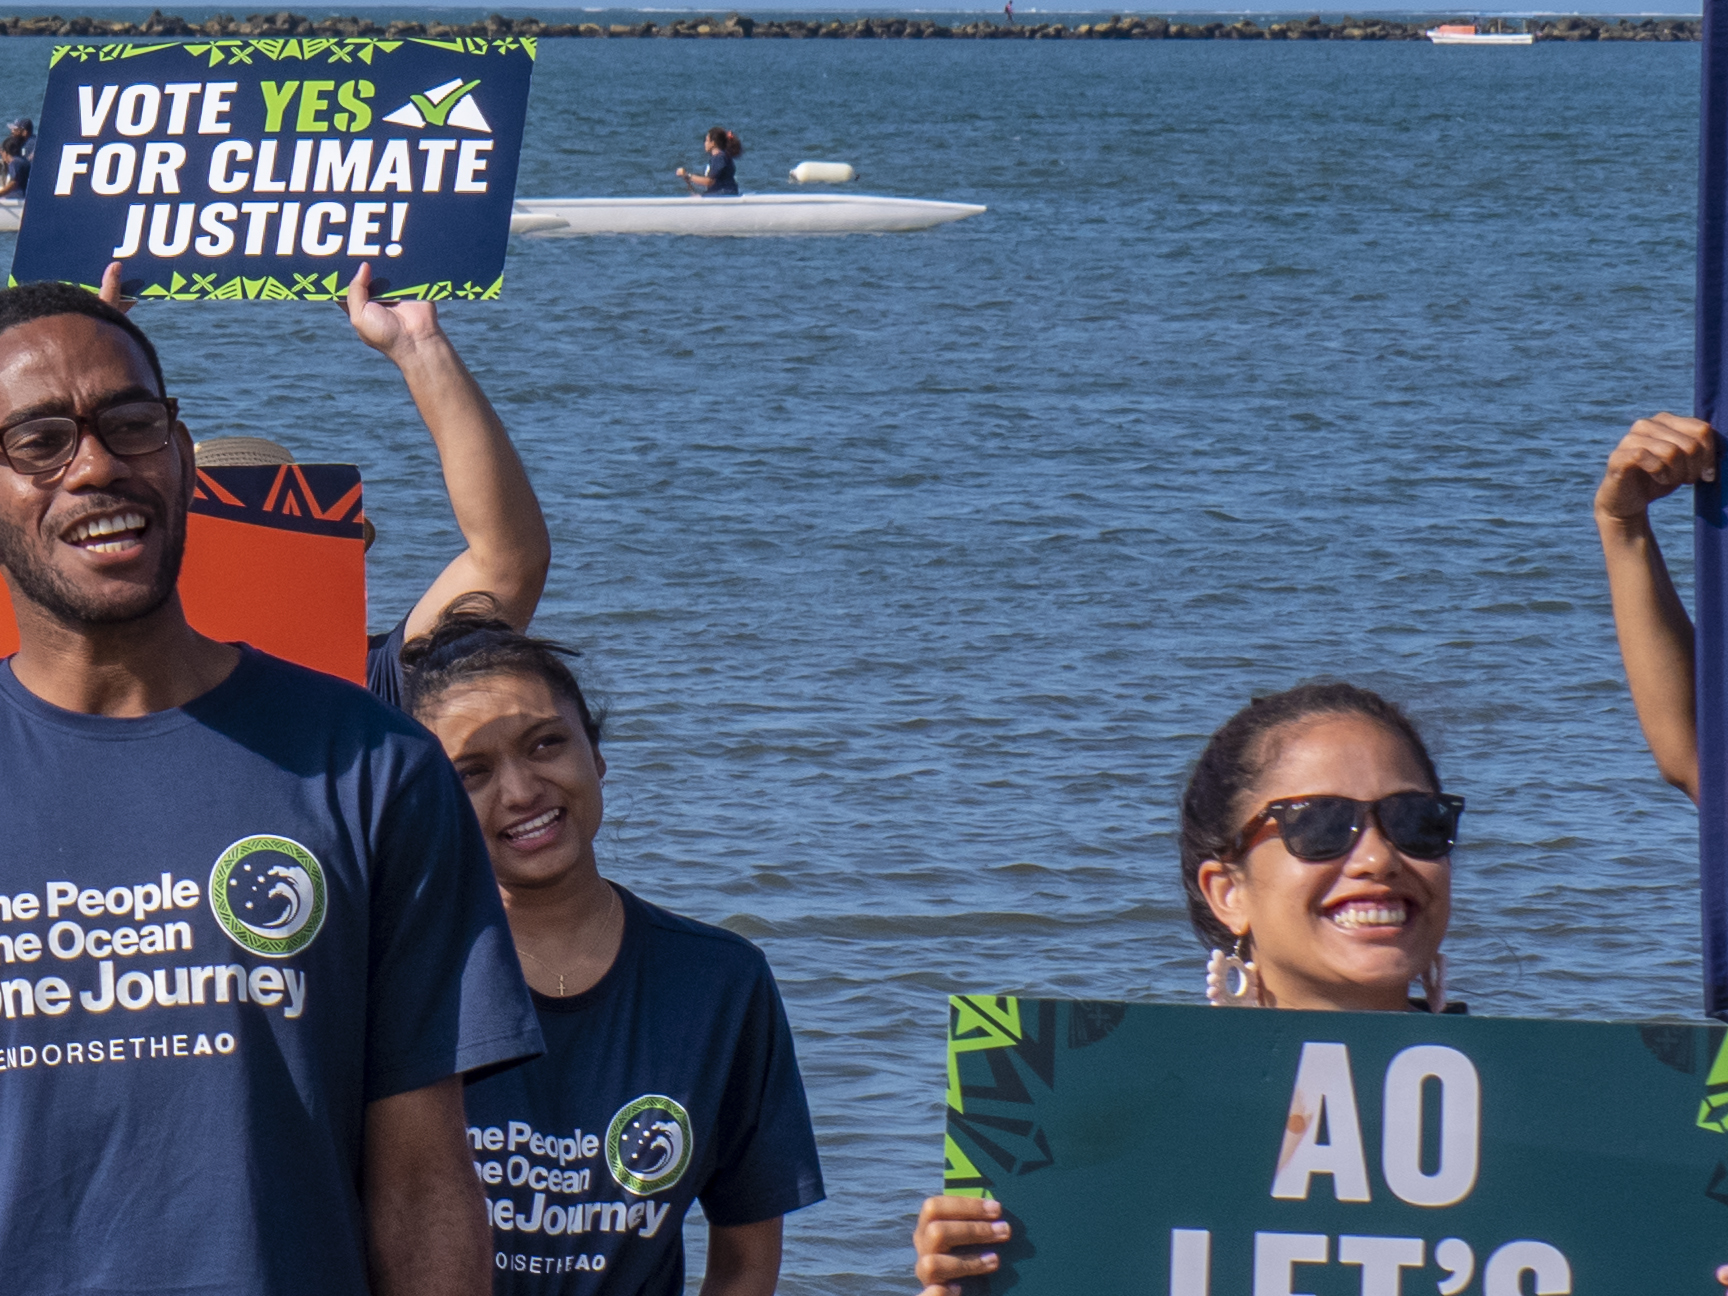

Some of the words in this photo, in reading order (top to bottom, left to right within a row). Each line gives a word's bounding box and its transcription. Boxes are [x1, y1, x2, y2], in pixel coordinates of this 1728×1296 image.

[78, 82, 238, 137] VOTE
[259, 79, 376, 133] YES
[54, 141, 186, 195] FOR
[207, 138, 494, 195] CLIMATE
[112, 201, 409, 258] JUSTICE!
[46, 872, 201, 921] People
[47, 919, 193, 960] Ocean
[79, 960, 306, 1019] Journey
[466, 1125, 505, 1151] ne
[507, 1119, 600, 1167] People
[1270, 1040, 1481, 1207] AO
[506, 1154, 592, 1194] Ocean
[515, 1191, 672, 1239] Journey
